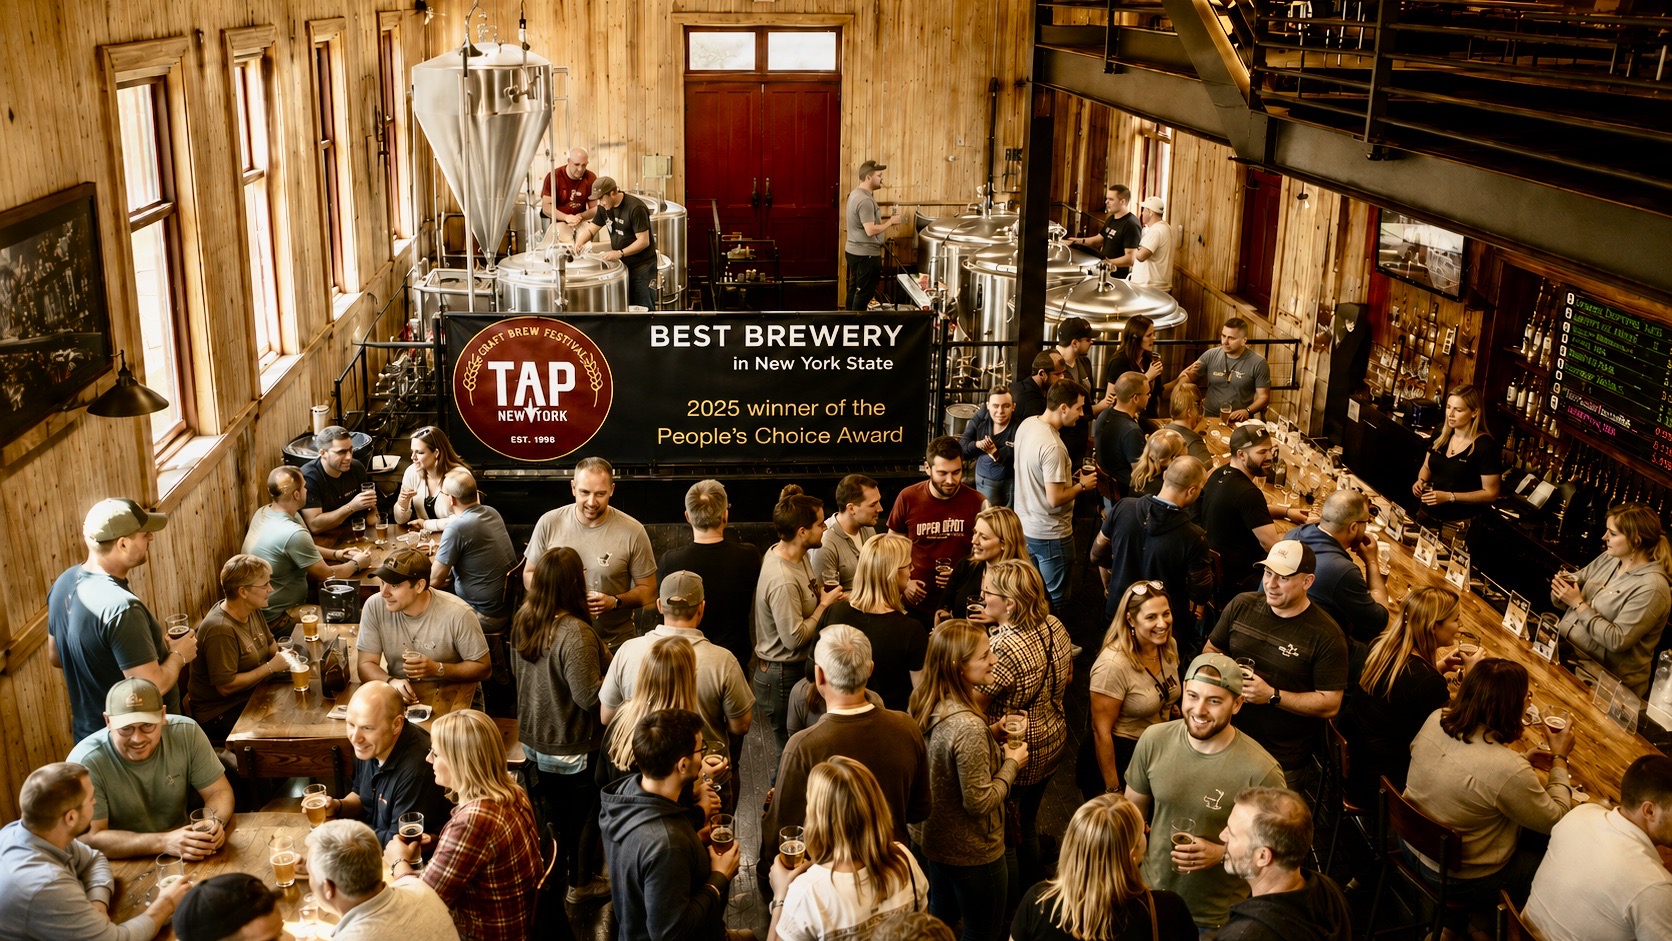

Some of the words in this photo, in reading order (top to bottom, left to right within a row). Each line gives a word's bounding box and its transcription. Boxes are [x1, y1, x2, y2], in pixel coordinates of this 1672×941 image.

[478, 332, 505, 356] CRAFT
[507, 326, 540, 339] BREW
[543, 328, 588, 361] FESTIVAL
[650, 324, 732, 347] BEST
[745, 324, 903, 347] BREWERY
[733, 356, 749, 371] in
[755, 356, 795, 371] New
[800, 355, 841, 371] York
[846, 356, 894, 371] State
[487, 361, 576, 407] TAP
[497, 410, 526, 422] NEW
[535, 410, 568, 422] YORK
[687, 399, 740, 417] 2025
[747, 399, 819, 417] winner
[825, 398, 847, 416] of
[852, 398, 886, 416] the
[510, 436, 532, 444] EST.
[534, 436, 556, 444] 1998
[657, 427, 748, 449] People’s
[755, 427, 831, 444] Choice
[836, 426, 903, 443] Award
[916, 521, 941, 536] UPPER
